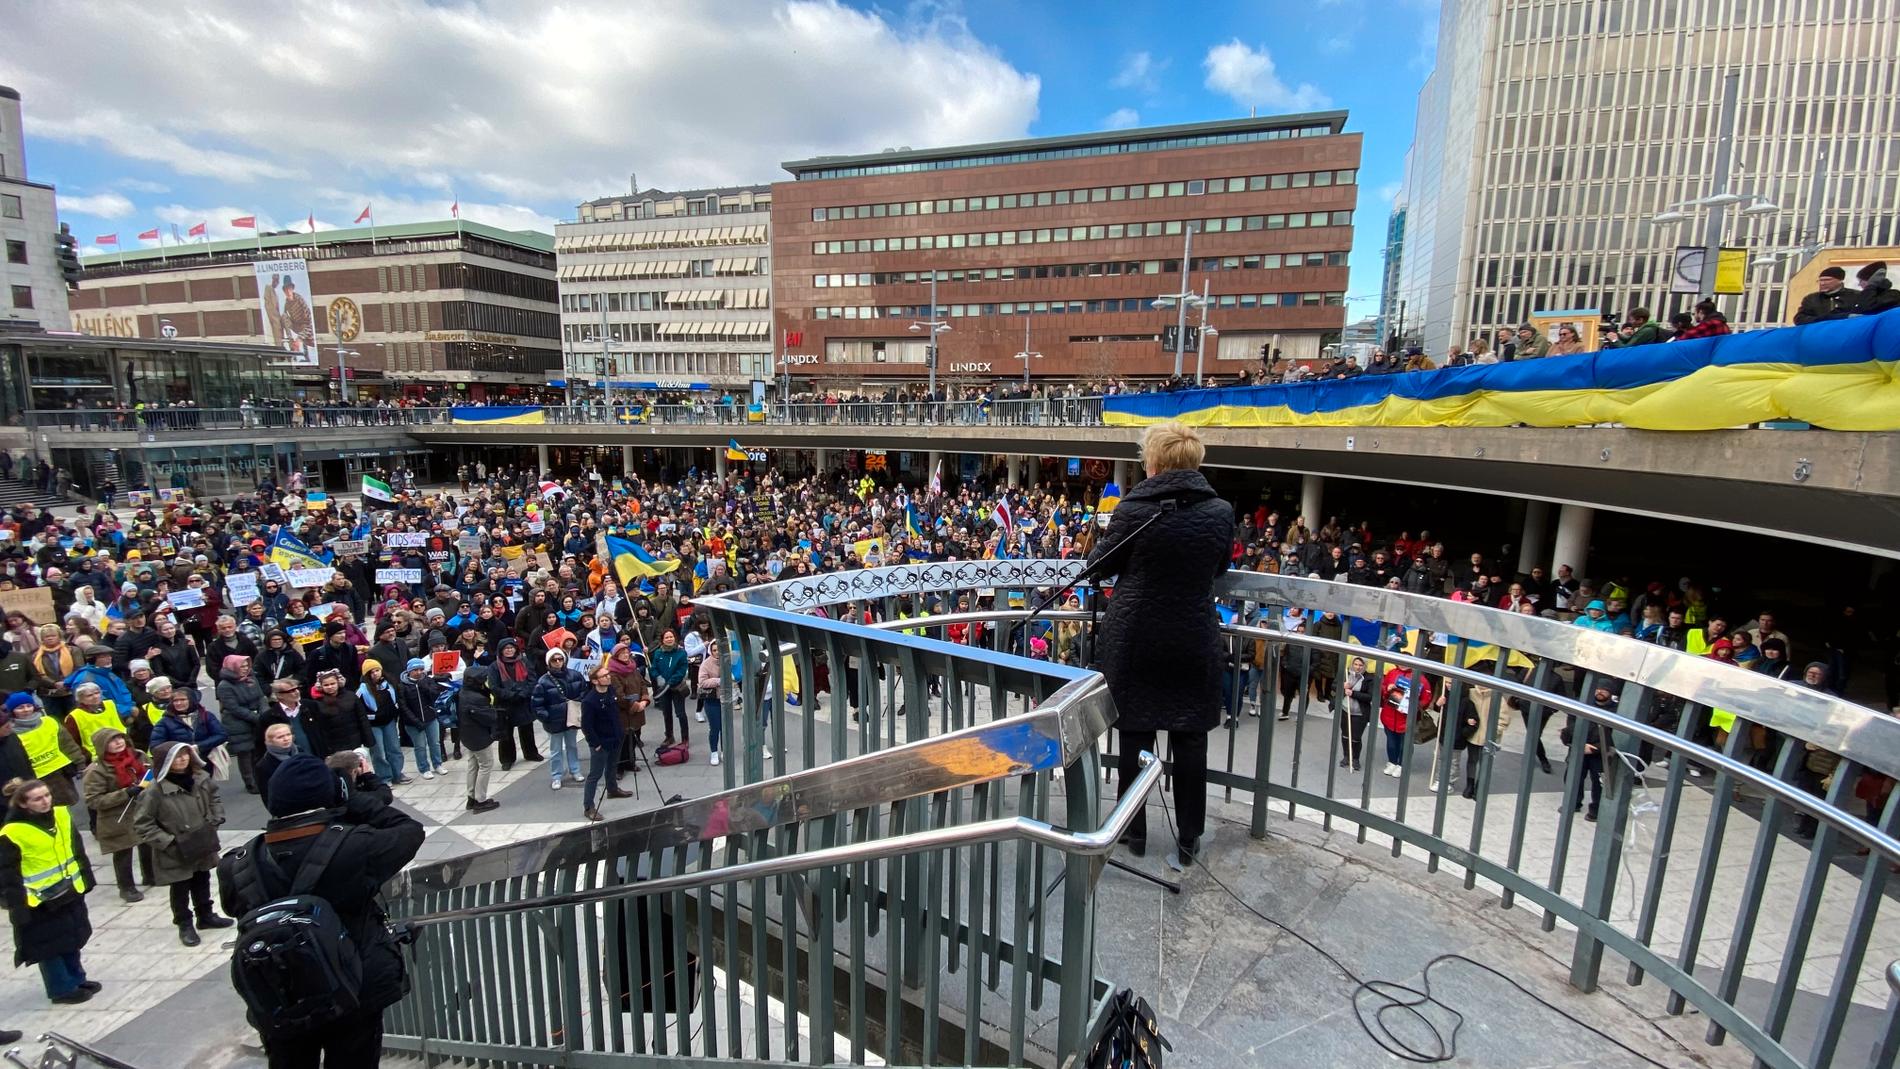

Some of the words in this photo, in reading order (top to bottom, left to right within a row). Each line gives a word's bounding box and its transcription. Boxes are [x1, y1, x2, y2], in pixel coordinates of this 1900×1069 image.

[76, 313, 134, 338] ÅHLÉNS
[950, 362, 992, 372] LINDEX
[388, 534, 409, 546] KIDS
[427, 550, 449, 558] WAR
